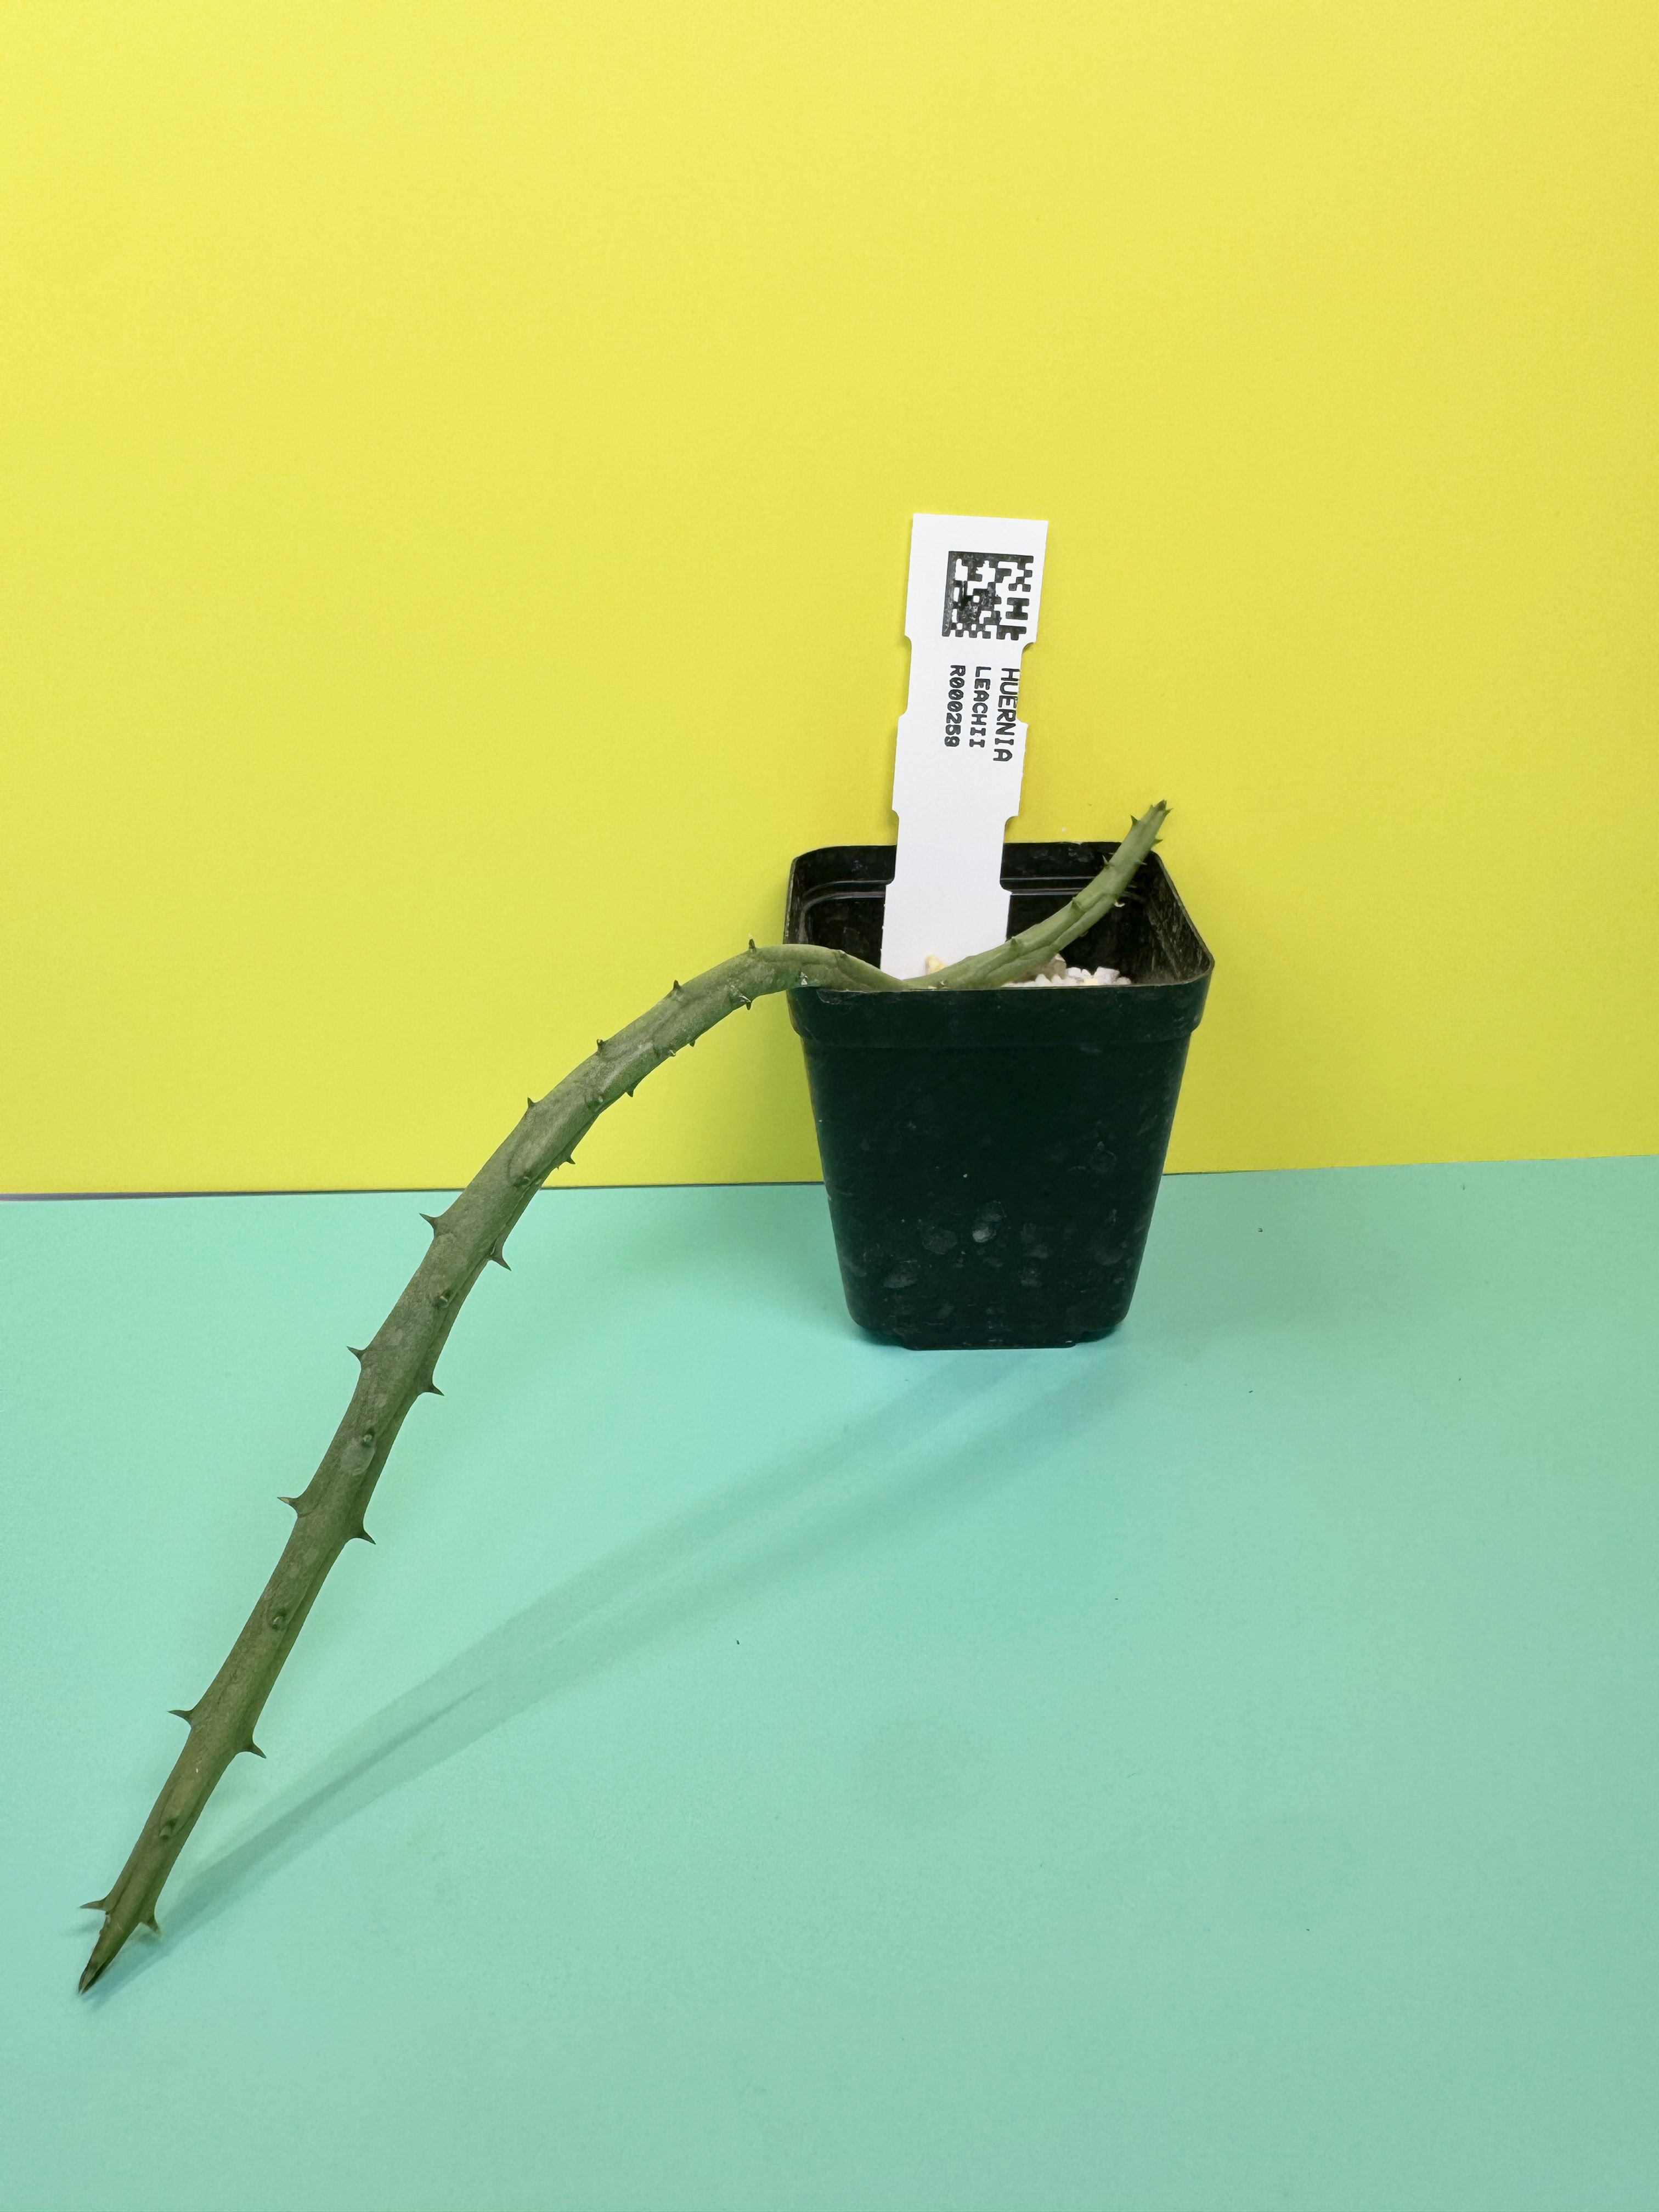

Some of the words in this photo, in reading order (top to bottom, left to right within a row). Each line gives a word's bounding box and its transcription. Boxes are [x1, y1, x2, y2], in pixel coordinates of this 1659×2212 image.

[944, 665, 966, 747] R000259
[969, 666, 991, 748] LEACHII
[993, 668, 1020, 761] HUERNIA
